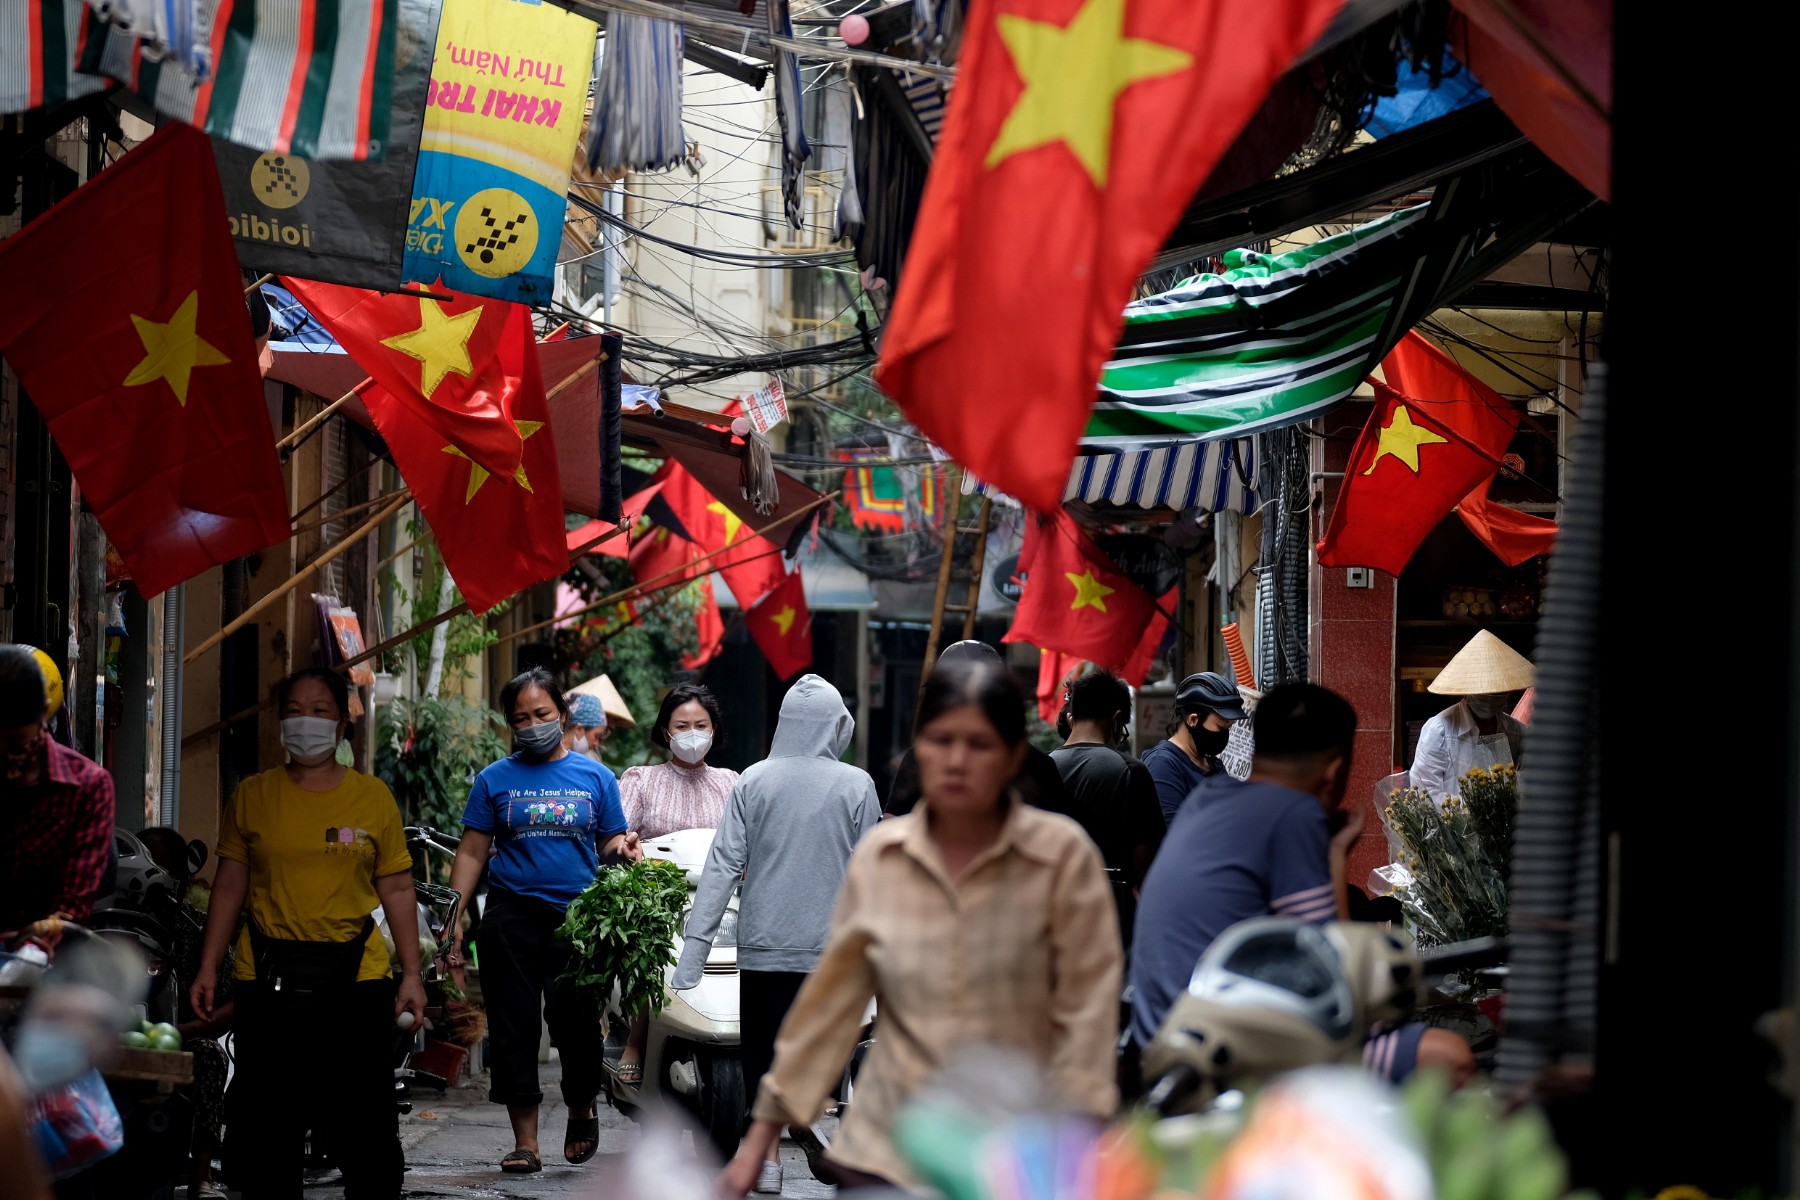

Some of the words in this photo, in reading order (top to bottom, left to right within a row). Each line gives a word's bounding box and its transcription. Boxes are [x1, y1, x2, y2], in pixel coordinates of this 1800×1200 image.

[446, 41, 511, 78] Năm,
[514, 58, 566, 87] Thứ
[480, 88, 563, 128] KHAI
[406, 225, 444, 255] Điệ
[508, 789, 521, 798] We
[523, 789, 537, 797] Are
[564, 788, 592, 799] Helpers
[527, 829, 547, 838] United
